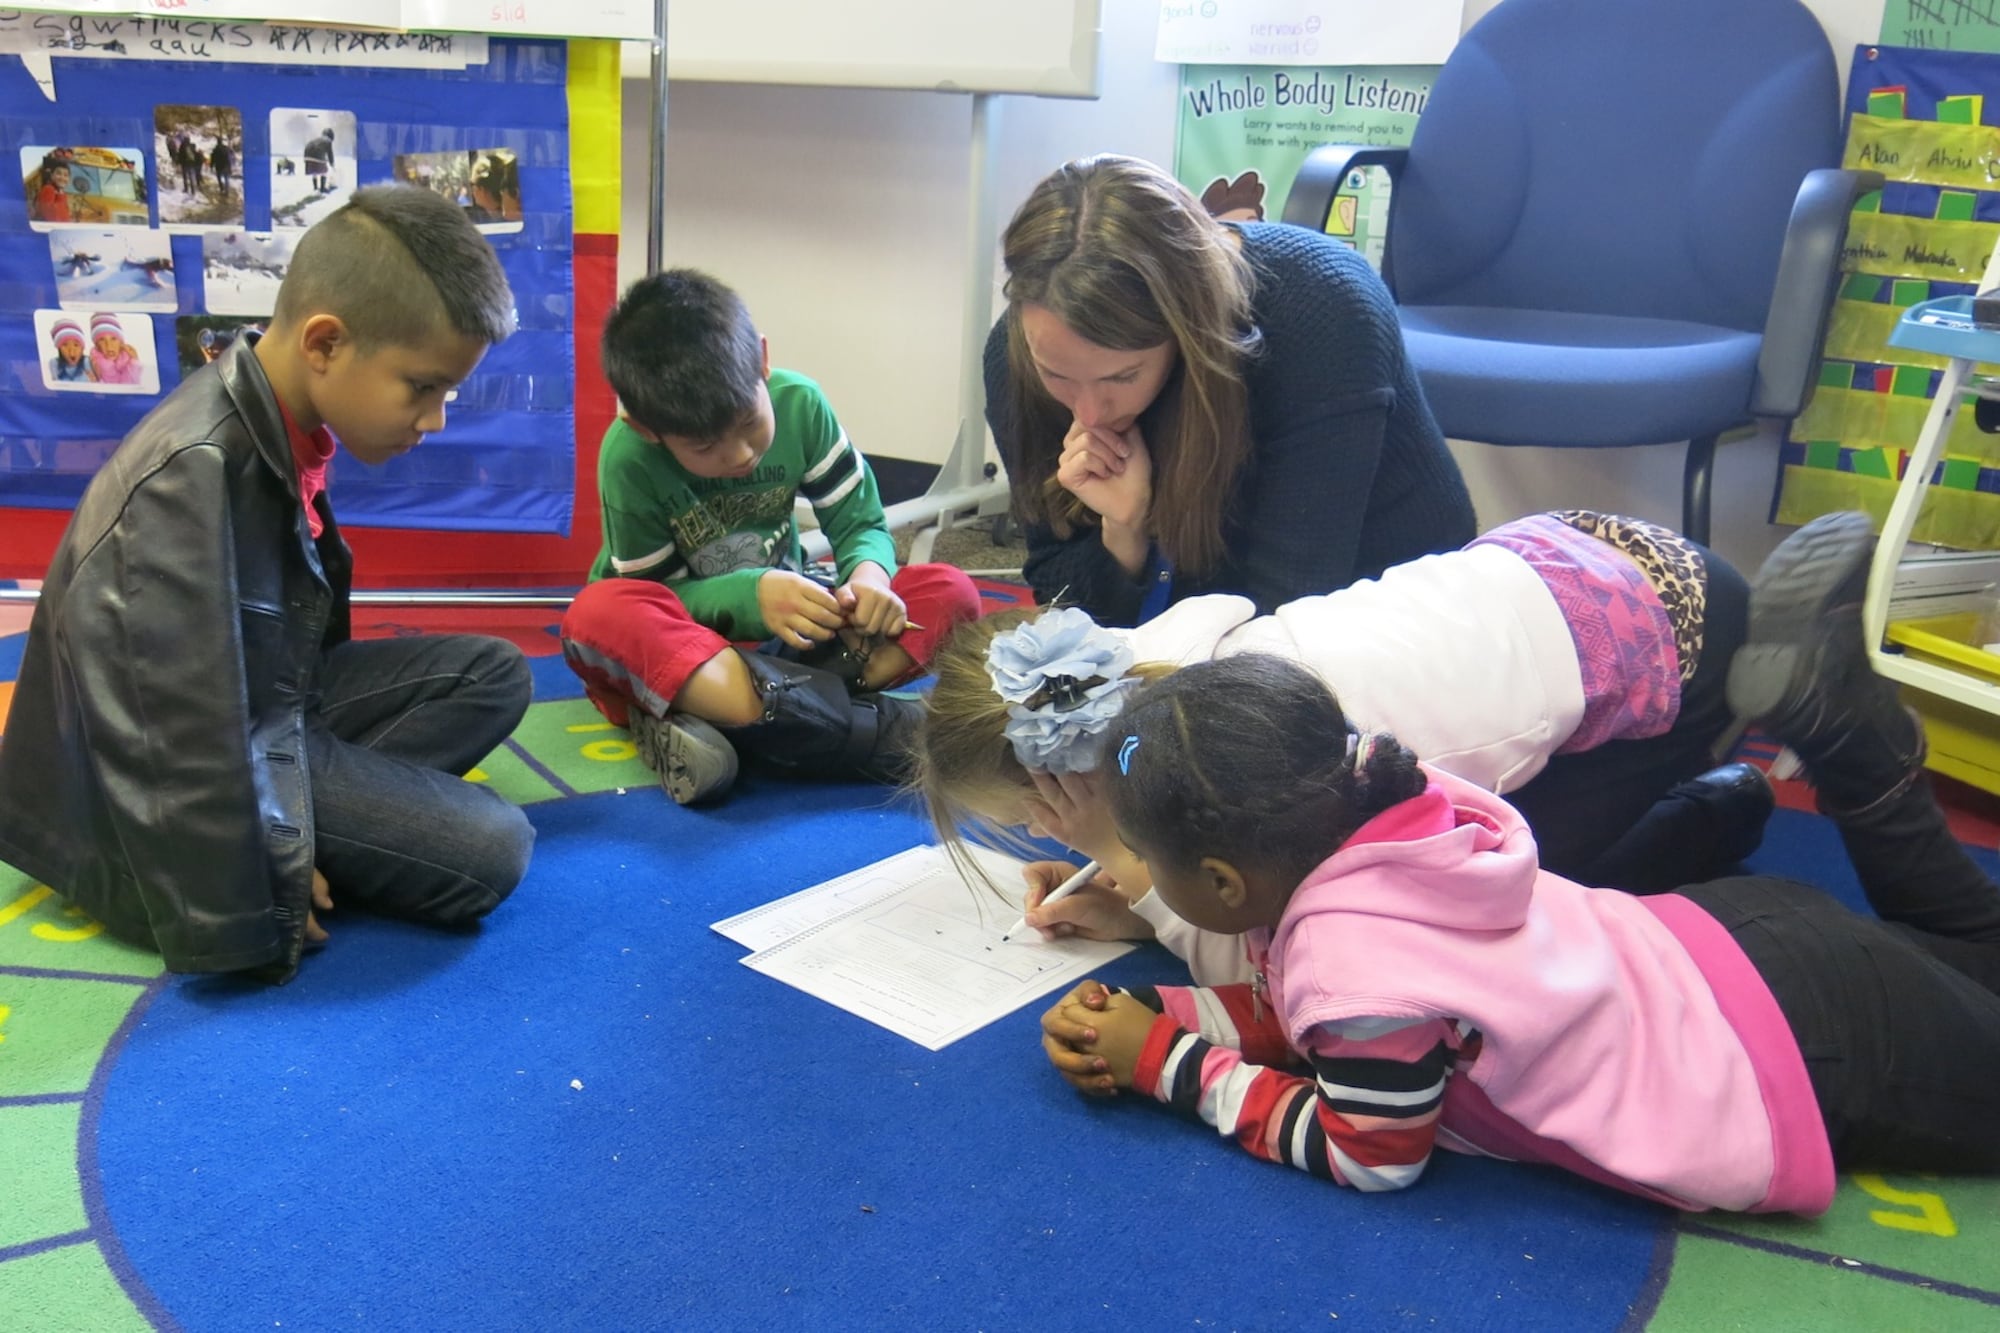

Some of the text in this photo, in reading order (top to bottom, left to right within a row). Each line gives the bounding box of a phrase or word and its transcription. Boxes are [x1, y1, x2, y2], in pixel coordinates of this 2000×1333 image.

[1190, 72, 1428, 117] Whole Body Listeni
[1243, 119, 1404, 136] Larry wants to remind you to
[1245, 134, 1273, 146] listen
[1278, 136, 1300, 147] with
[1860, 143, 1899, 165] Alan
